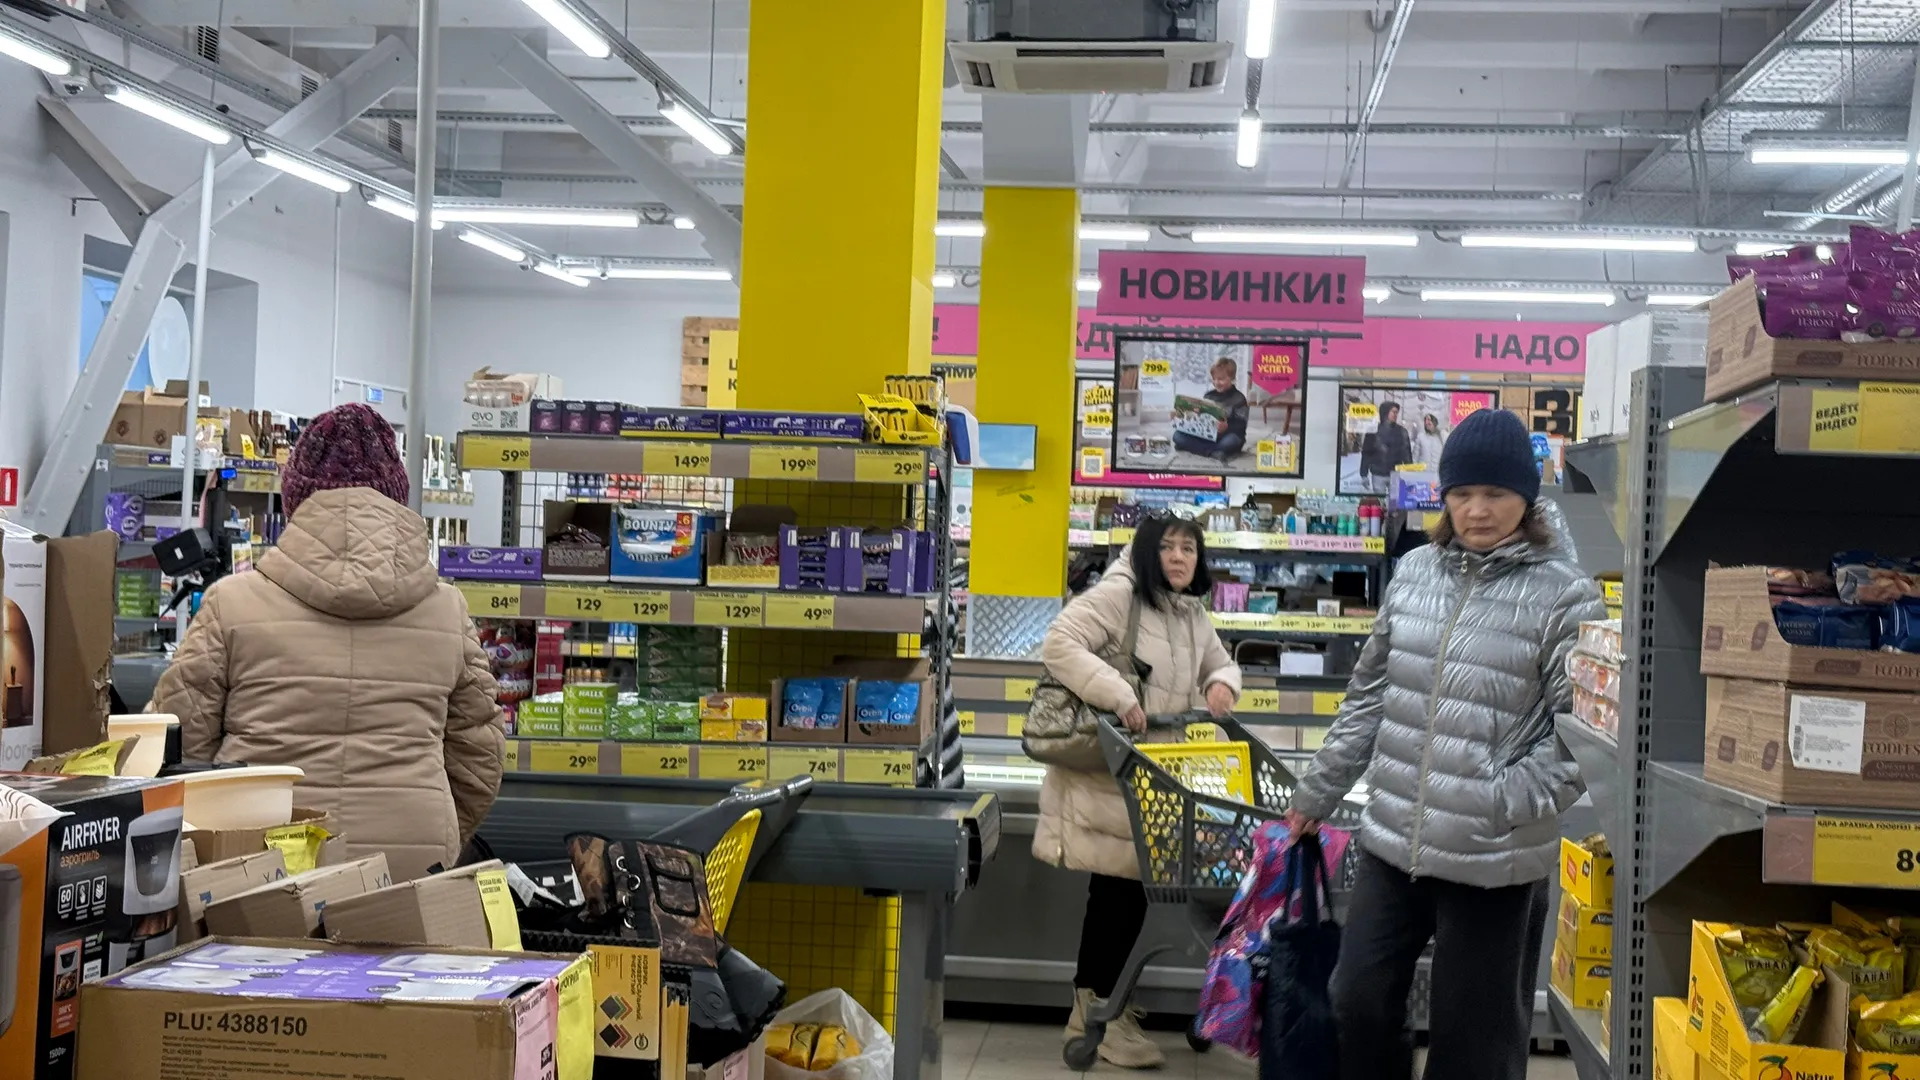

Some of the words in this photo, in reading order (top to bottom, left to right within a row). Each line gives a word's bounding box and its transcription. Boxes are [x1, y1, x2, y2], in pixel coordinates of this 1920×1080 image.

[1118, 267, 1347, 305] НОВИНКИ!
[1474, 332, 1579, 362] НАДО
[1261, 354, 1291, 365] НАДО
[1257, 364, 1294, 375] УСПЕТЬ
[1815, 416, 1858, 432] ВИДЕО
[623, 519, 674, 533] BOUNTY
[578, 689, 604, 699] HALLS
[534, 705, 559, 714] HALLS
[578, 706, 604, 715] HALLS
[790, 703, 813, 714] Orbit
[860, 708, 883, 718] Orbit
[533, 722, 559, 731] HALLS
[578, 723, 604, 732] HALLS
[1817, 820, 1837, 828] ЯДРА
[1839, 821, 1875, 830] АРАХИСА
[60, 816, 121, 852] AIRFRYER
[60, 850, 101, 870] аэрогриль
[60, 888, 72, 903] 60
[1749, 959, 1790, 971] БАНАН
[1854, 972, 1892, 984] БАНАН
[163, 1011, 213, 1031] PLU:
[216, 1012, 308, 1037] 4388150
